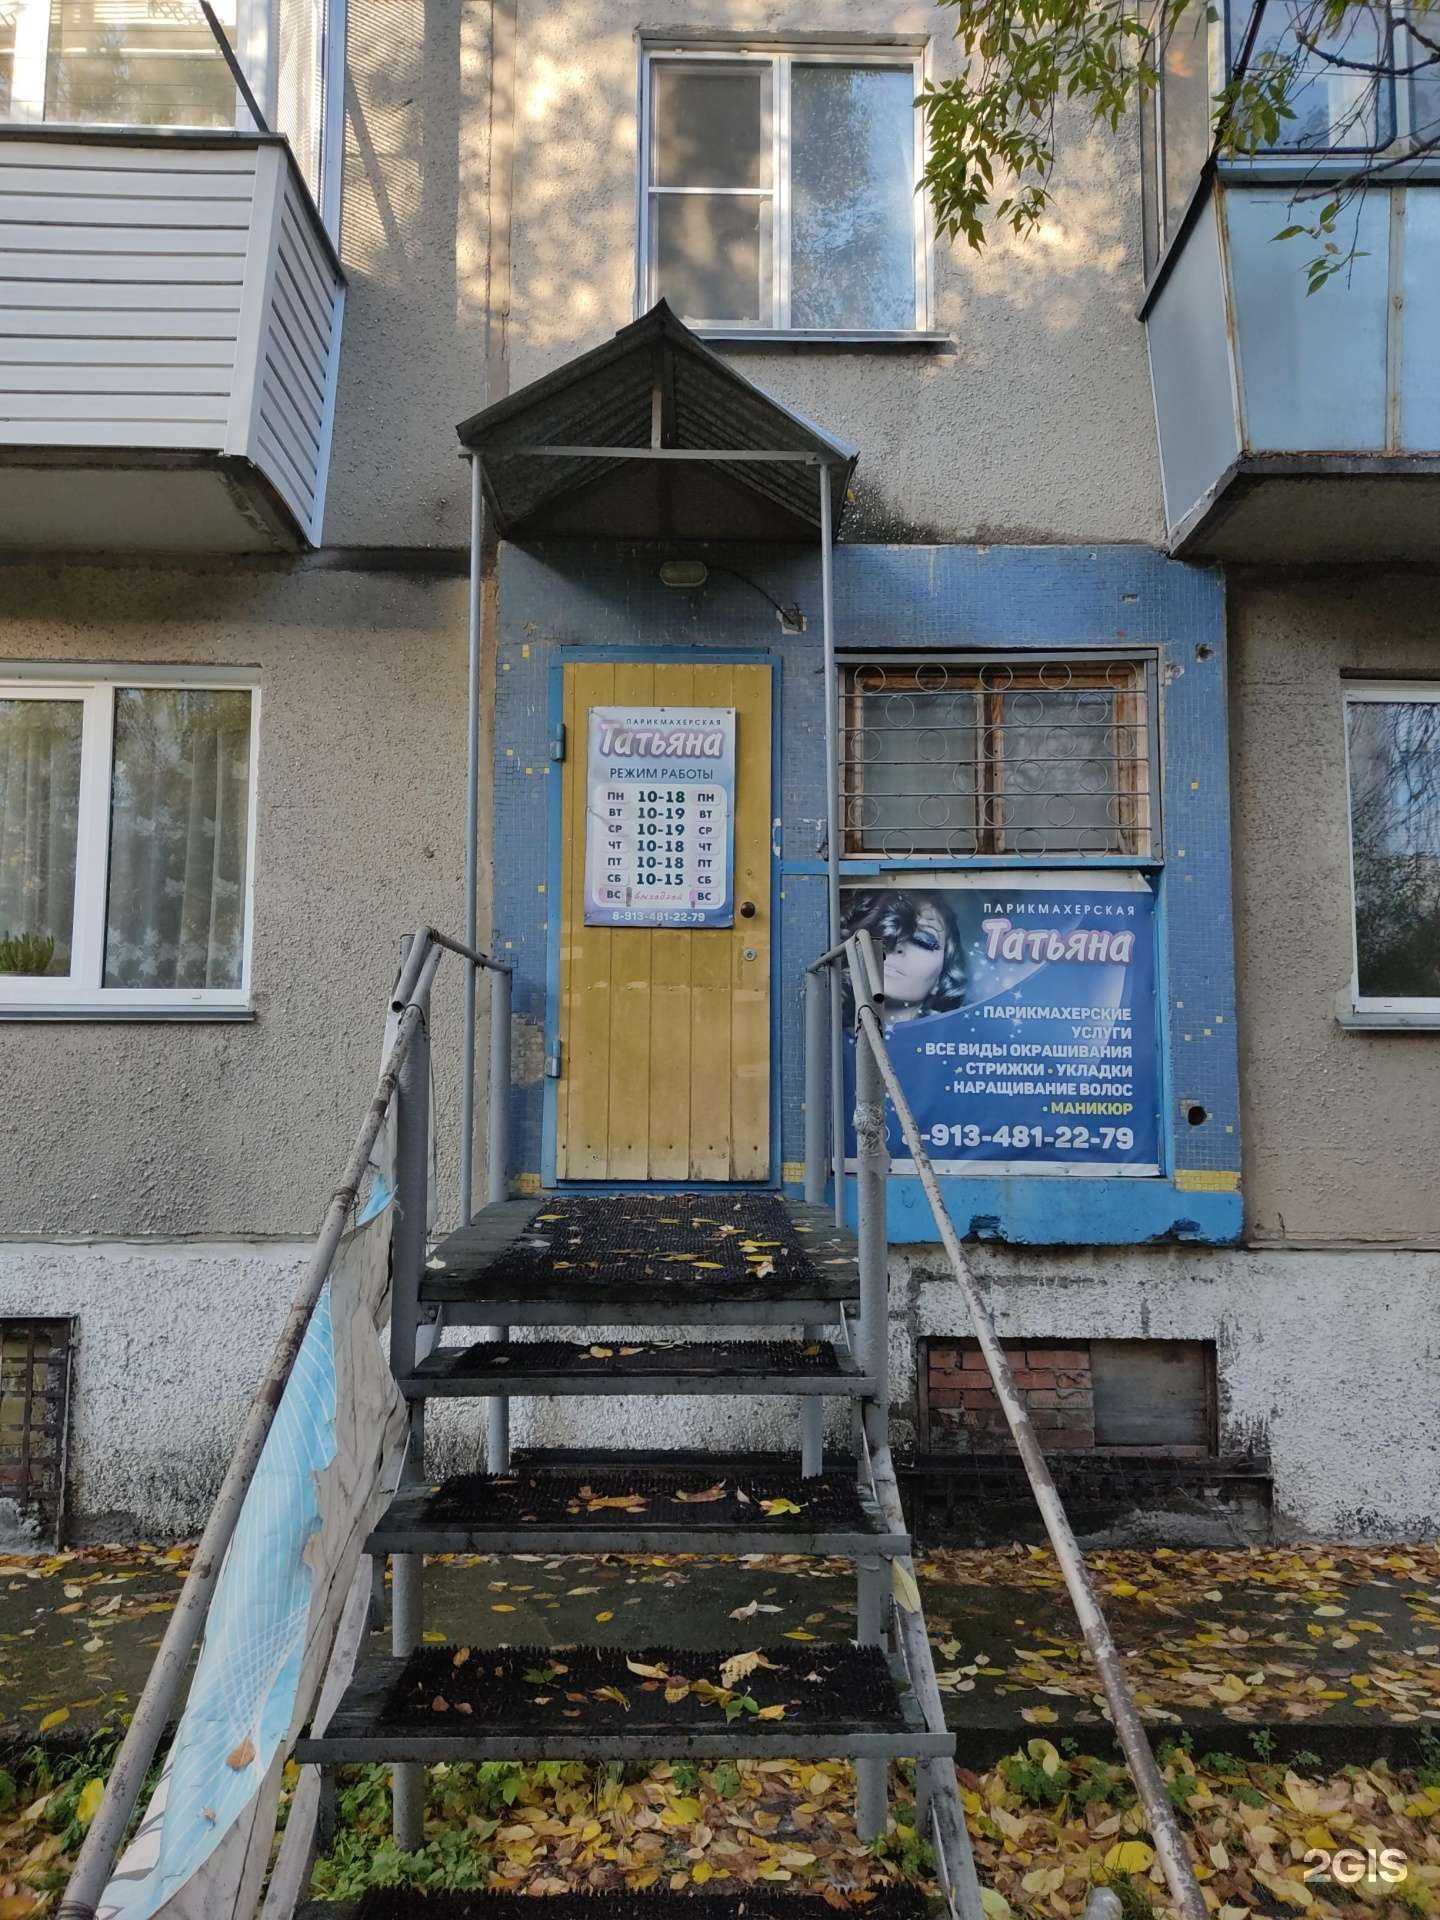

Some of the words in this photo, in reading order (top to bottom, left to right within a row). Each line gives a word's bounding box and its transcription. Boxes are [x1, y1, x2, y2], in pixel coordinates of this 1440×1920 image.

[626, 718, 721, 726] ПАРИКМАХЕРСКАЯ
[600, 721, 723, 757] Татьяна
[610, 768, 658, 779] РЕЖИМ
[661, 768, 713, 780] РАБОТЫ
[607, 791, 624, 801] ПН
[638, 791, 686, 803] 10-18
[697, 793, 715, 802] ПН
[609, 808, 622, 816] ВТ
[638, 807, 686, 819] 10-19
[700, 810, 713, 819] ВТ
[608, 825, 622, 833] СР
[637, 824, 685, 836] 10-19
[698, 826, 713, 835] СР
[608, 841, 622, 850] ЧТ
[637, 840, 685, 852] 10-18
[698, 842, 712, 851] ЧТ
[607, 857, 622, 866] ПТ
[636, 856, 685, 868] 10-18
[697, 859, 712, 868] ПТ
[607, 874, 621, 883] СБ
[636, 873, 684, 885] 10-15
[697, 875, 712, 884] СБ
[606, 890, 621, 899] ВС
[697, 892, 711, 901] ВС
[983, 903, 1135, 916] ПАРИКМАХЕРСКАЯ
[612, 911, 705, 922] 8-913-481-22-79
[982, 918, 1135, 964] Татьяна
[983, 1006, 1132, 1021] ПАРИКМАХЕРСКИЕ
[1071, 1026, 1132, 1040] УСЛУГИ
[925, 1043, 956, 1056] ВСЕ
[958, 1043, 1007, 1058] ВИДЫ
[1010, 1044, 1133, 1058] ОКРАШИВАНИЯ
[966, 1063, 1044, 1076] СТРИЖКИ
[1056, 1064, 1133, 1079] УКЛАДКИ
[953, 1081, 1077, 1096] НАРАЩИВАНИЕ
[1080, 1083, 1133, 1097] ВОЛОС
[1051, 1102, 1133, 1115] МАНИКЮР
[902, 1123, 1134, 1150] -913-481-22-79
